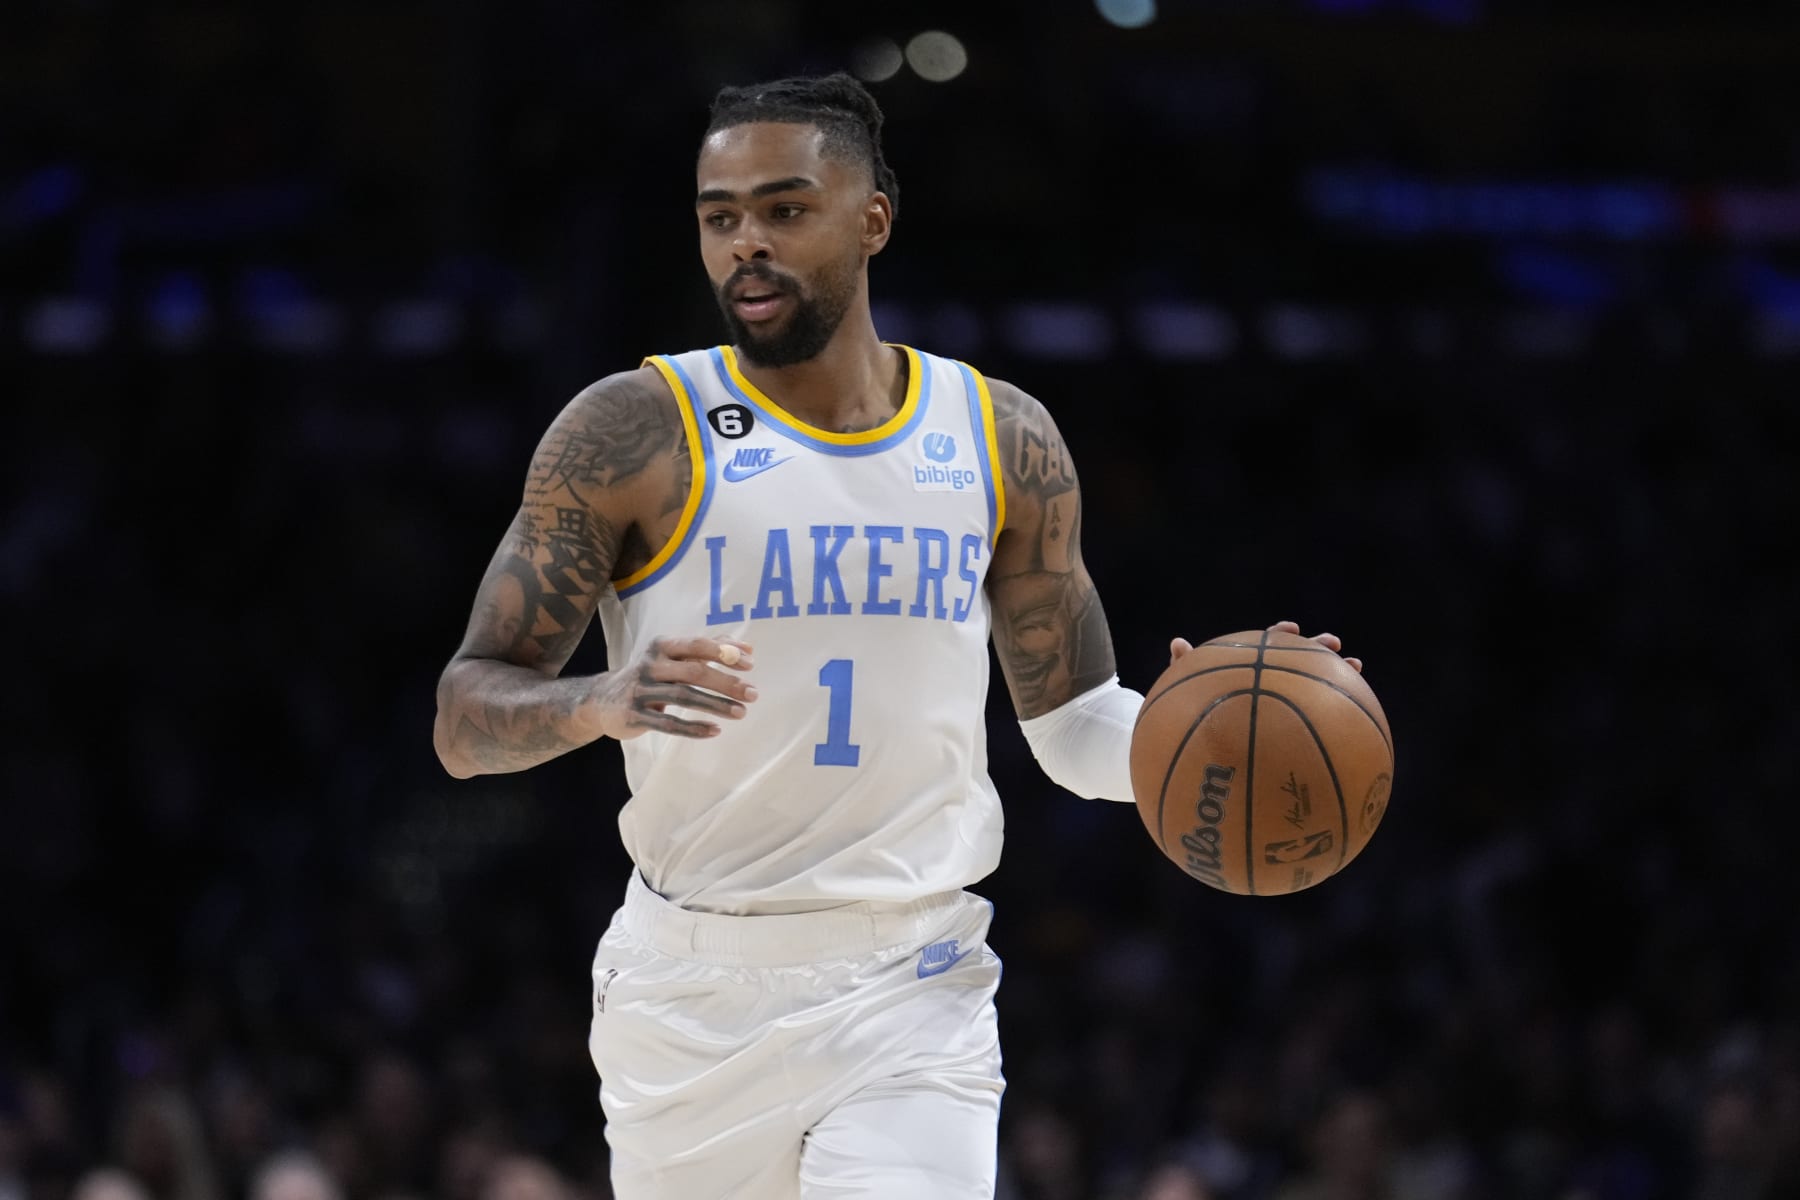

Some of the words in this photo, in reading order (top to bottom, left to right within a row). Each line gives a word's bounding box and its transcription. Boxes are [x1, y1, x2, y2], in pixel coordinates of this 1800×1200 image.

[716, 408, 742, 436] 6
[732, 447, 776, 467] NIKE
[914, 466, 975, 490] bibigo
[705, 525, 982, 626] LAKERS
[816, 658, 860, 768] 1
[922, 939, 960, 964] NIKE
